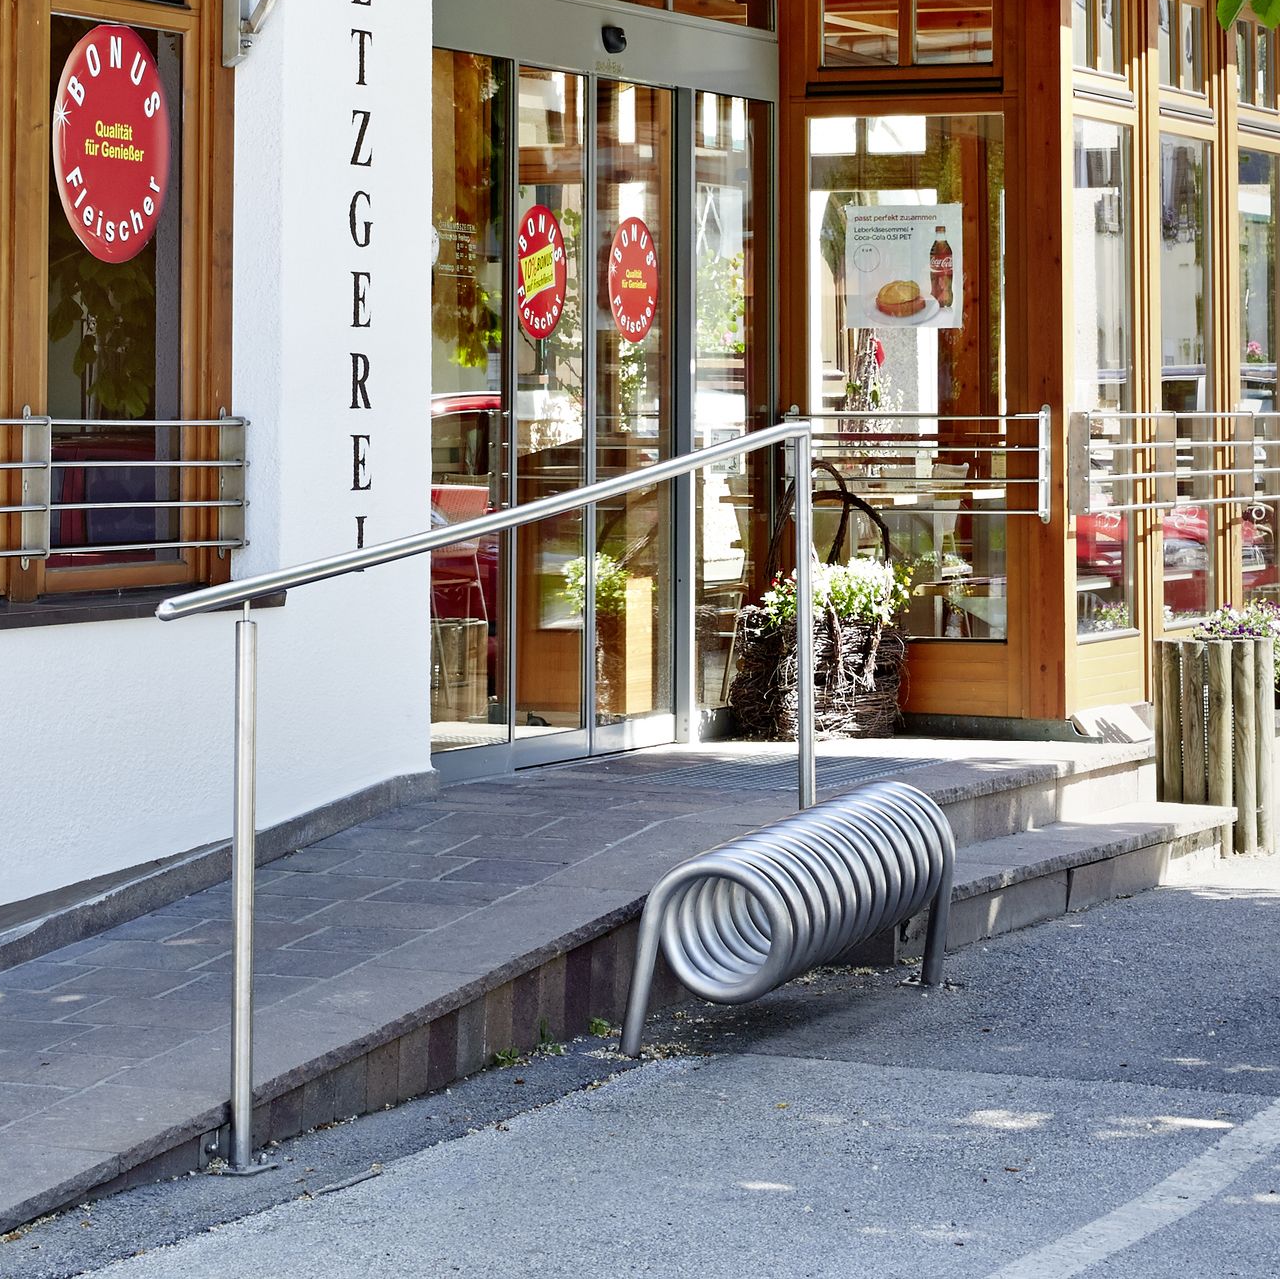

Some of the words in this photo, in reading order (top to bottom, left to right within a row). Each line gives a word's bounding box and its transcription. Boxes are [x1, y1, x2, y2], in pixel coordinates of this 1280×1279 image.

[66, 35, 161, 118] BONUS
[85, 139, 99, 156] für
[101, 142, 145, 162] Genießer
[95, 120, 133, 142] Qualität
[66, 166, 161, 243] Fleischer
[873, 214, 898, 222] perfekt
[518, 213, 563, 262] BONUS
[613, 224, 654, 266] BONUS
[517, 284, 562, 330] Fleischer
[613, 294, 654, 333] Fleischer
